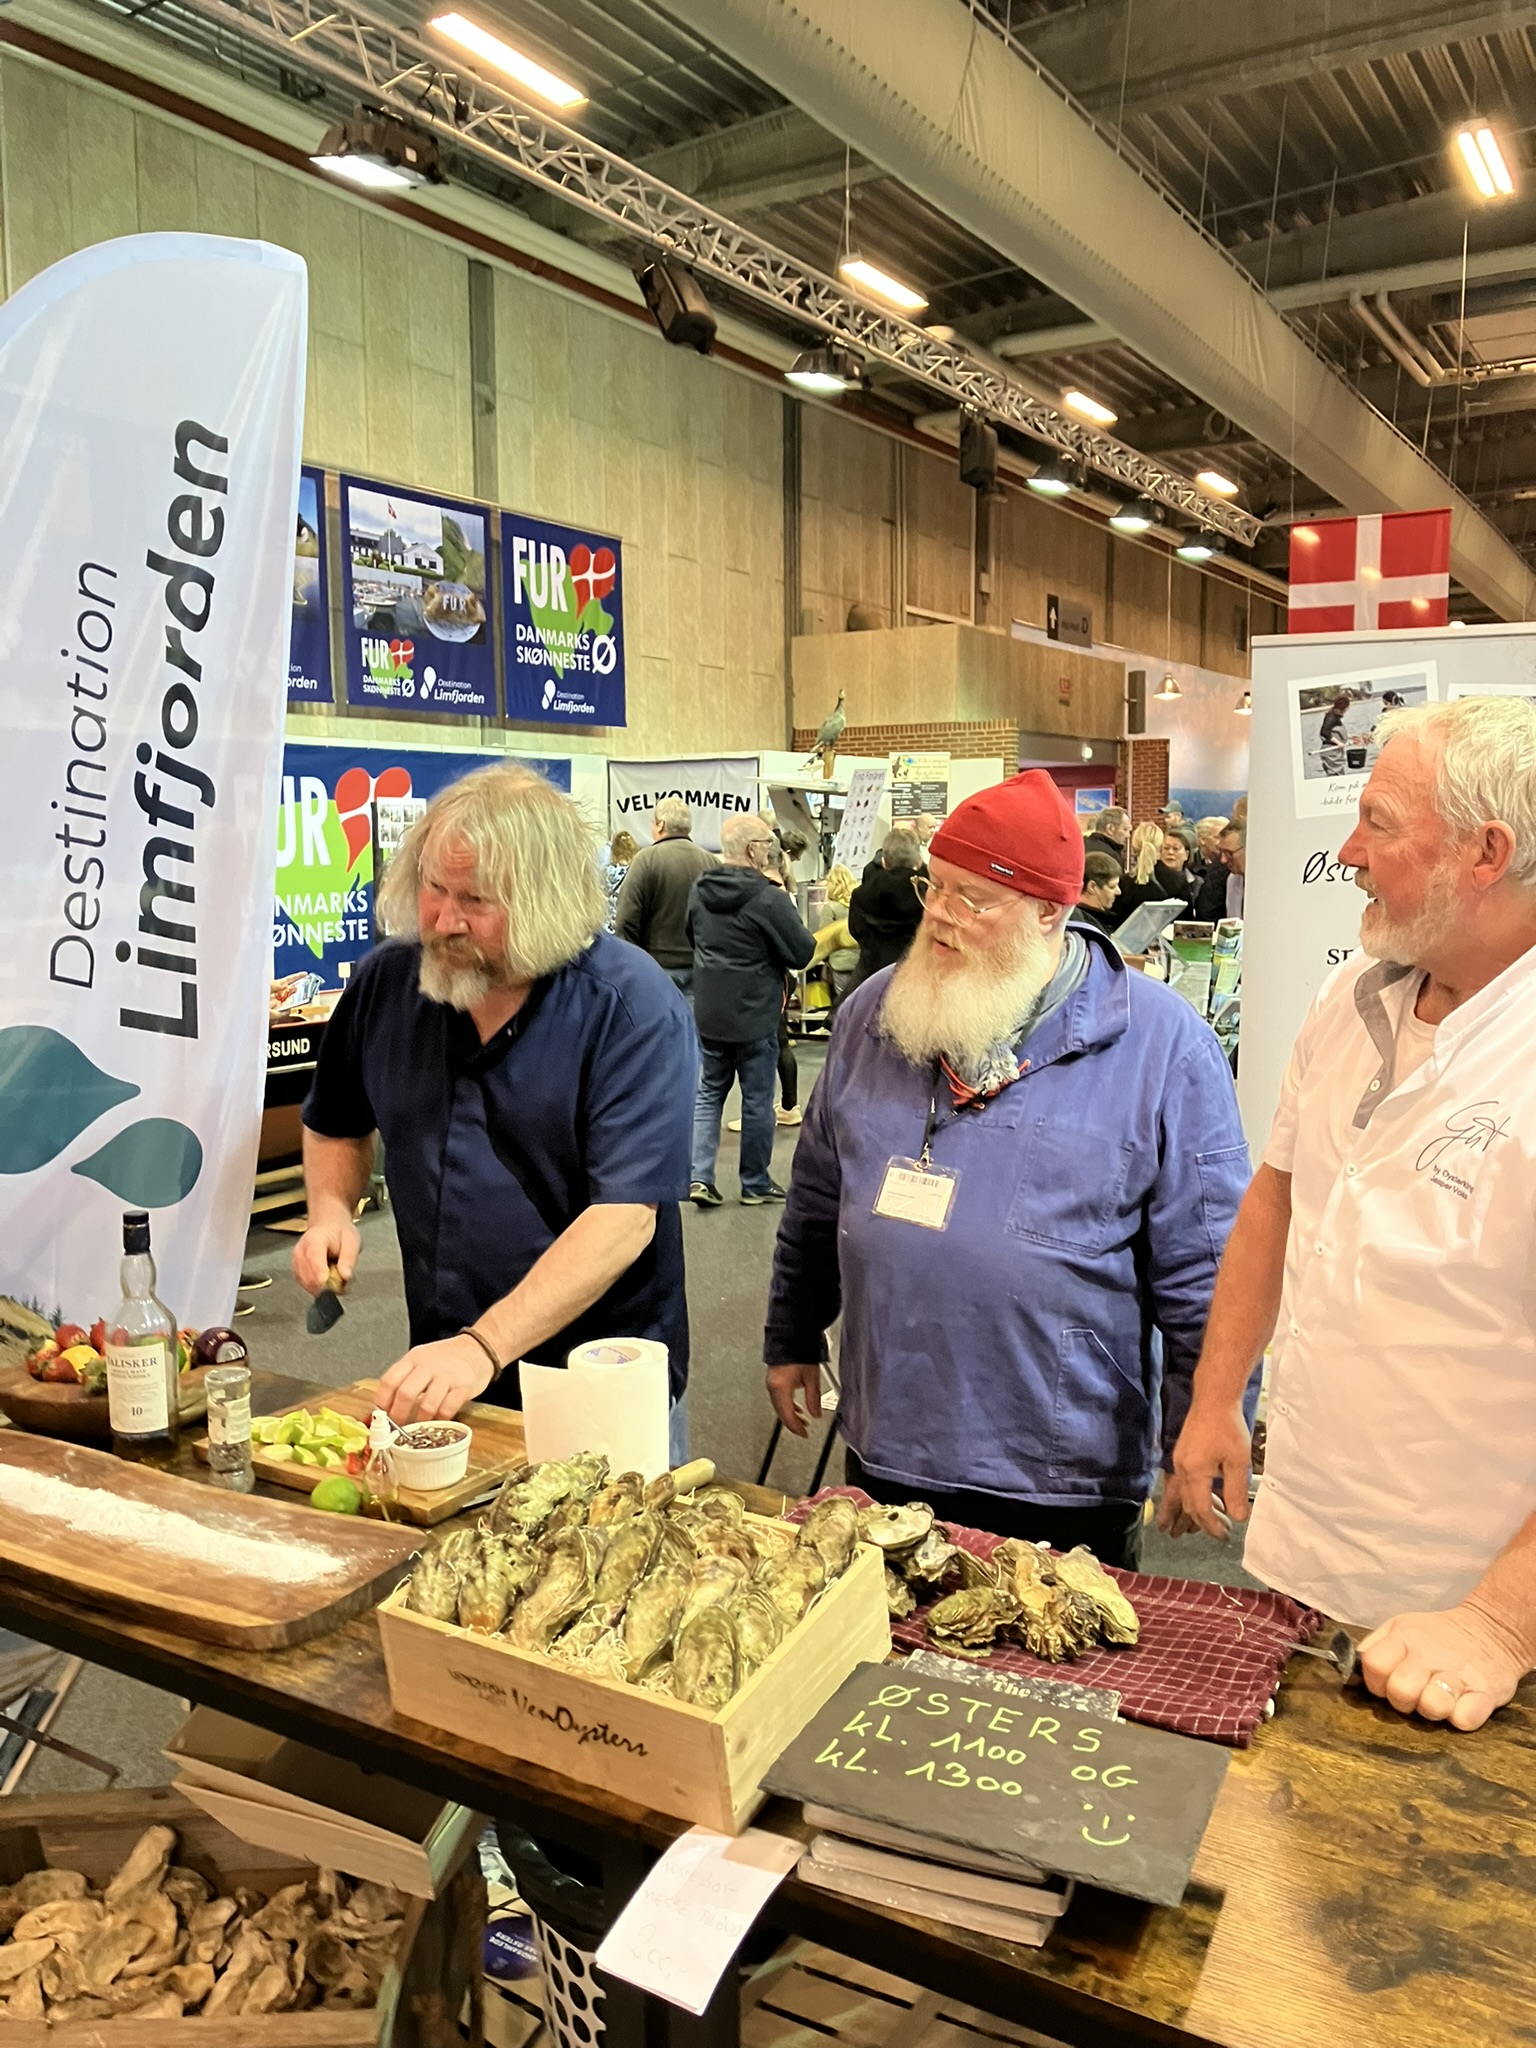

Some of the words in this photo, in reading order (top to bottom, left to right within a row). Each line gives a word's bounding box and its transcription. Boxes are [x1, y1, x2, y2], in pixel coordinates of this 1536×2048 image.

[513, 536, 568, 612] FUR
[516, 623, 590, 650] DANMARKS
[361, 637, 390, 669] FUR
[516, 645, 591, 673] SKØNNESTE
[592, 634, 616, 675] Ø
[287, 675, 318, 690] orden
[363, 675, 401, 686] DANMARKS
[401, 679, 416, 698] Ø
[438, 679, 472, 689] Destination
[434, 689, 485, 704] Limfjorden
[553, 700, 595, 714] Limfjorden
[115, 418, 229, 1037] Limfjorden
[50, 560, 118, 990] Destination
[276, 775, 331, 868] UR
[275, 890, 369, 917] NMARKS
[273, 918, 369, 947] ØNNESTE
[131, 1406, 143, 1417] 10
[992, 1680, 1031, 1697] The
[867, 1684, 1104, 1754] ØSTERS
[930, 1731, 1027, 1765] 1100
[905, 1760, 1023, 1796] 1300
